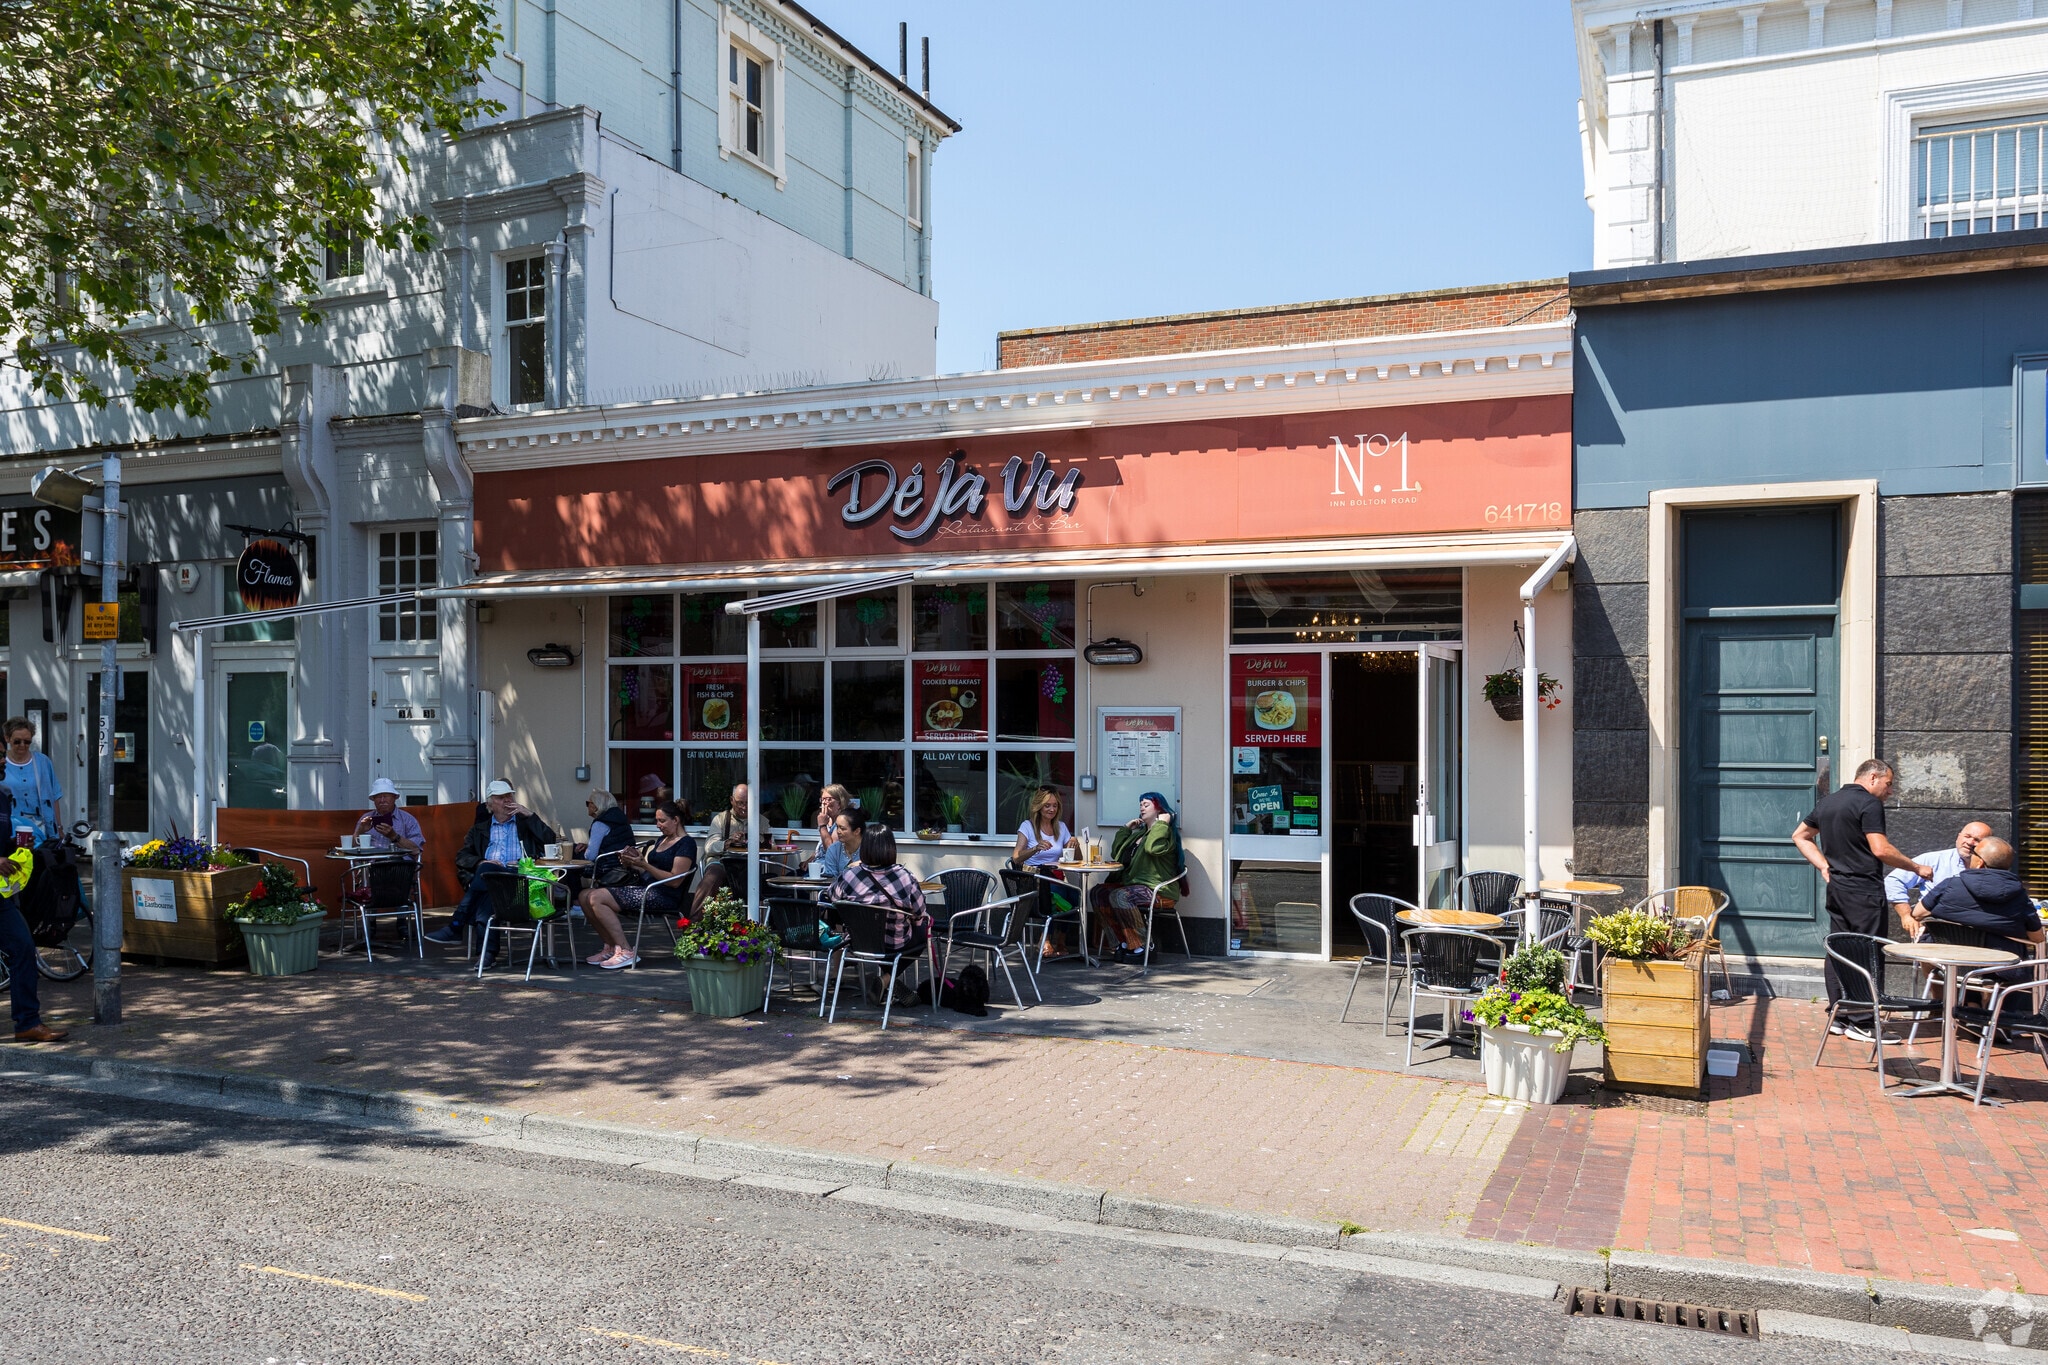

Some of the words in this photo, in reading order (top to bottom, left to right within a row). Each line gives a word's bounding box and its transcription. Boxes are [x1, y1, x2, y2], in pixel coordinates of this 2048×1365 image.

[1000, 451, 1080, 511] Vu
[1350, 498, 1387, 506] BOLTON
[1391, 496, 1417, 504] ROAD
[1484, 502, 1562, 523] 641718
[937, 520, 1027, 540] Restaurant
[1028, 515, 1044, 530] &
[1047, 514, 1083, 531] Bar
[244, 558, 293, 586] Flames
[925, 732, 955, 740] SERVED
[957, 732, 978, 740] HERE
[1245, 734, 1280, 743] SERVED
[1282, 734, 1307, 743] HERE
[1252, 789, 1268, 800] Come
[1252, 801, 1280, 812] OPEN
[144, 901, 174, 909] Eastbourne
